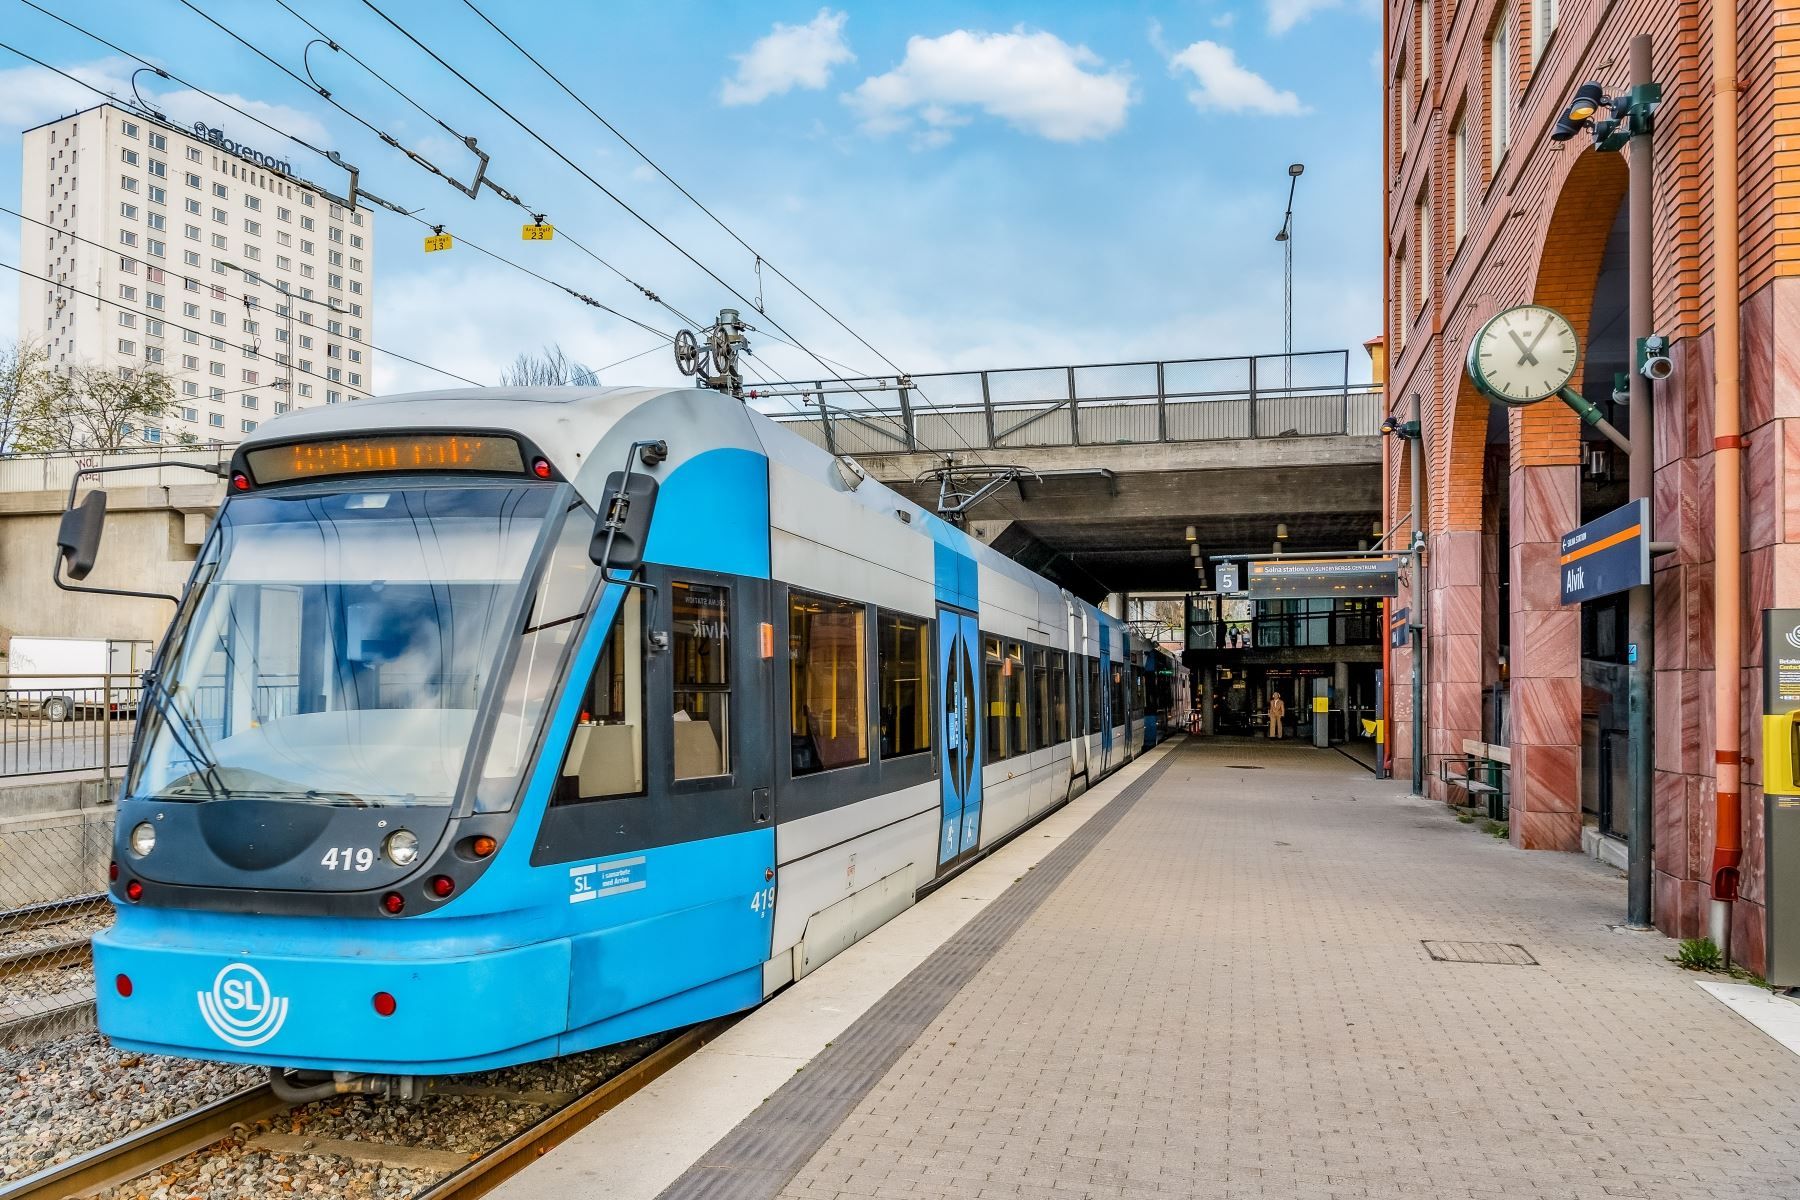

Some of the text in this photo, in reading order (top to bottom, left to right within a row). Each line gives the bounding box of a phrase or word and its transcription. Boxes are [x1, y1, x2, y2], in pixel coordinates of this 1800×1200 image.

[531, 231, 544, 239] 23
[433, 242, 444, 250] 13
[1223, 575, 1232, 588] 5
[1566, 566, 1585, 593] Alvik
[320, 847, 374, 872] 419
[574, 876, 592, 892] SL
[751, 887, 775, 912] 419
[223, 979, 262, 1011] SL
